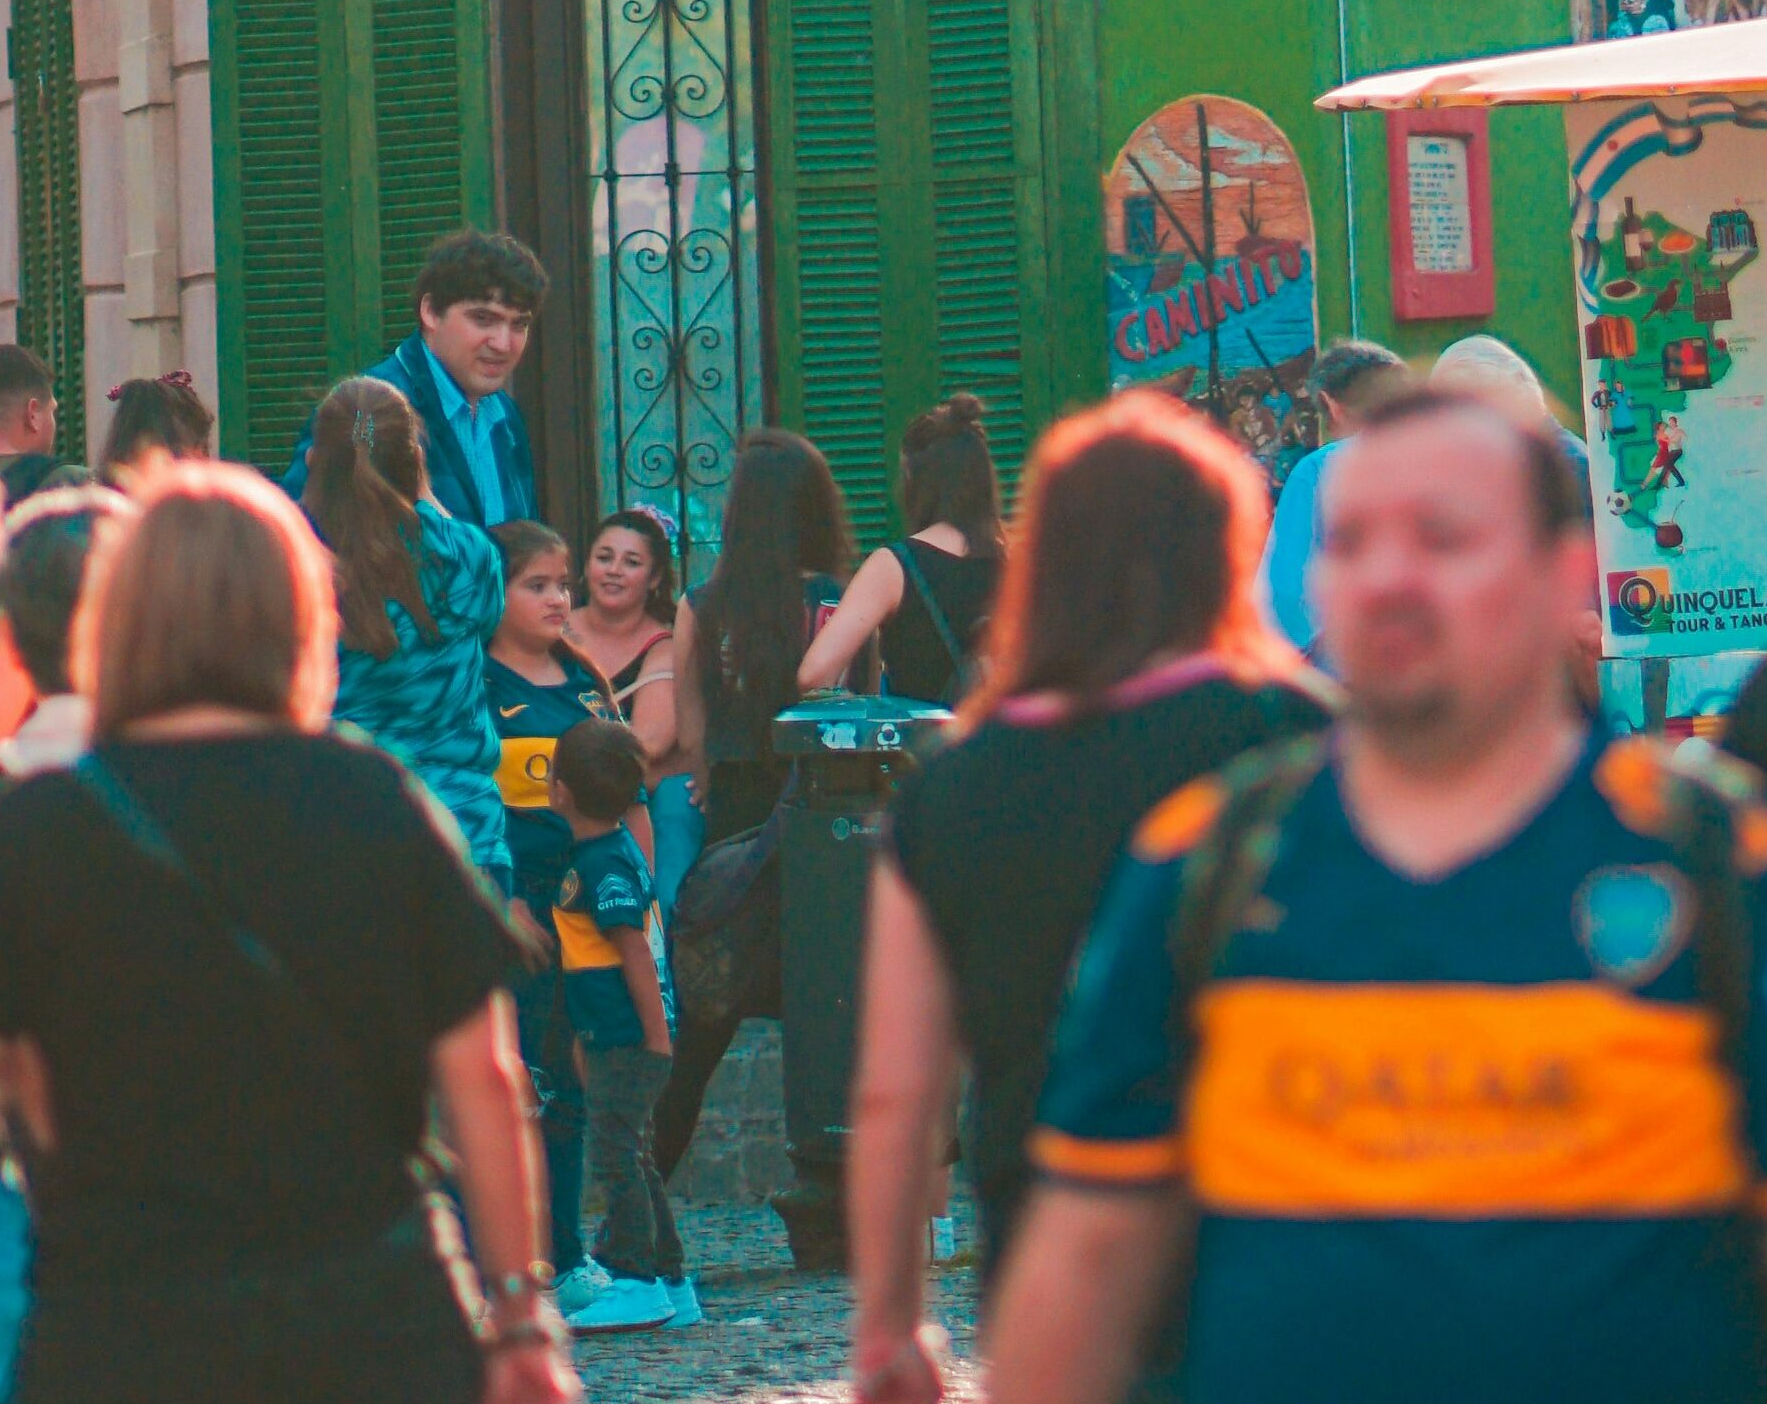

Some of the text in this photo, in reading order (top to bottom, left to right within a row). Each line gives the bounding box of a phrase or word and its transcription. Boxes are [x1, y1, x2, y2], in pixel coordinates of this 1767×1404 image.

[1114, 243, 1302, 363] CAMINITO
[1669, 617, 1709, 634] TOUR
[1714, 616, 1725, 630] &
